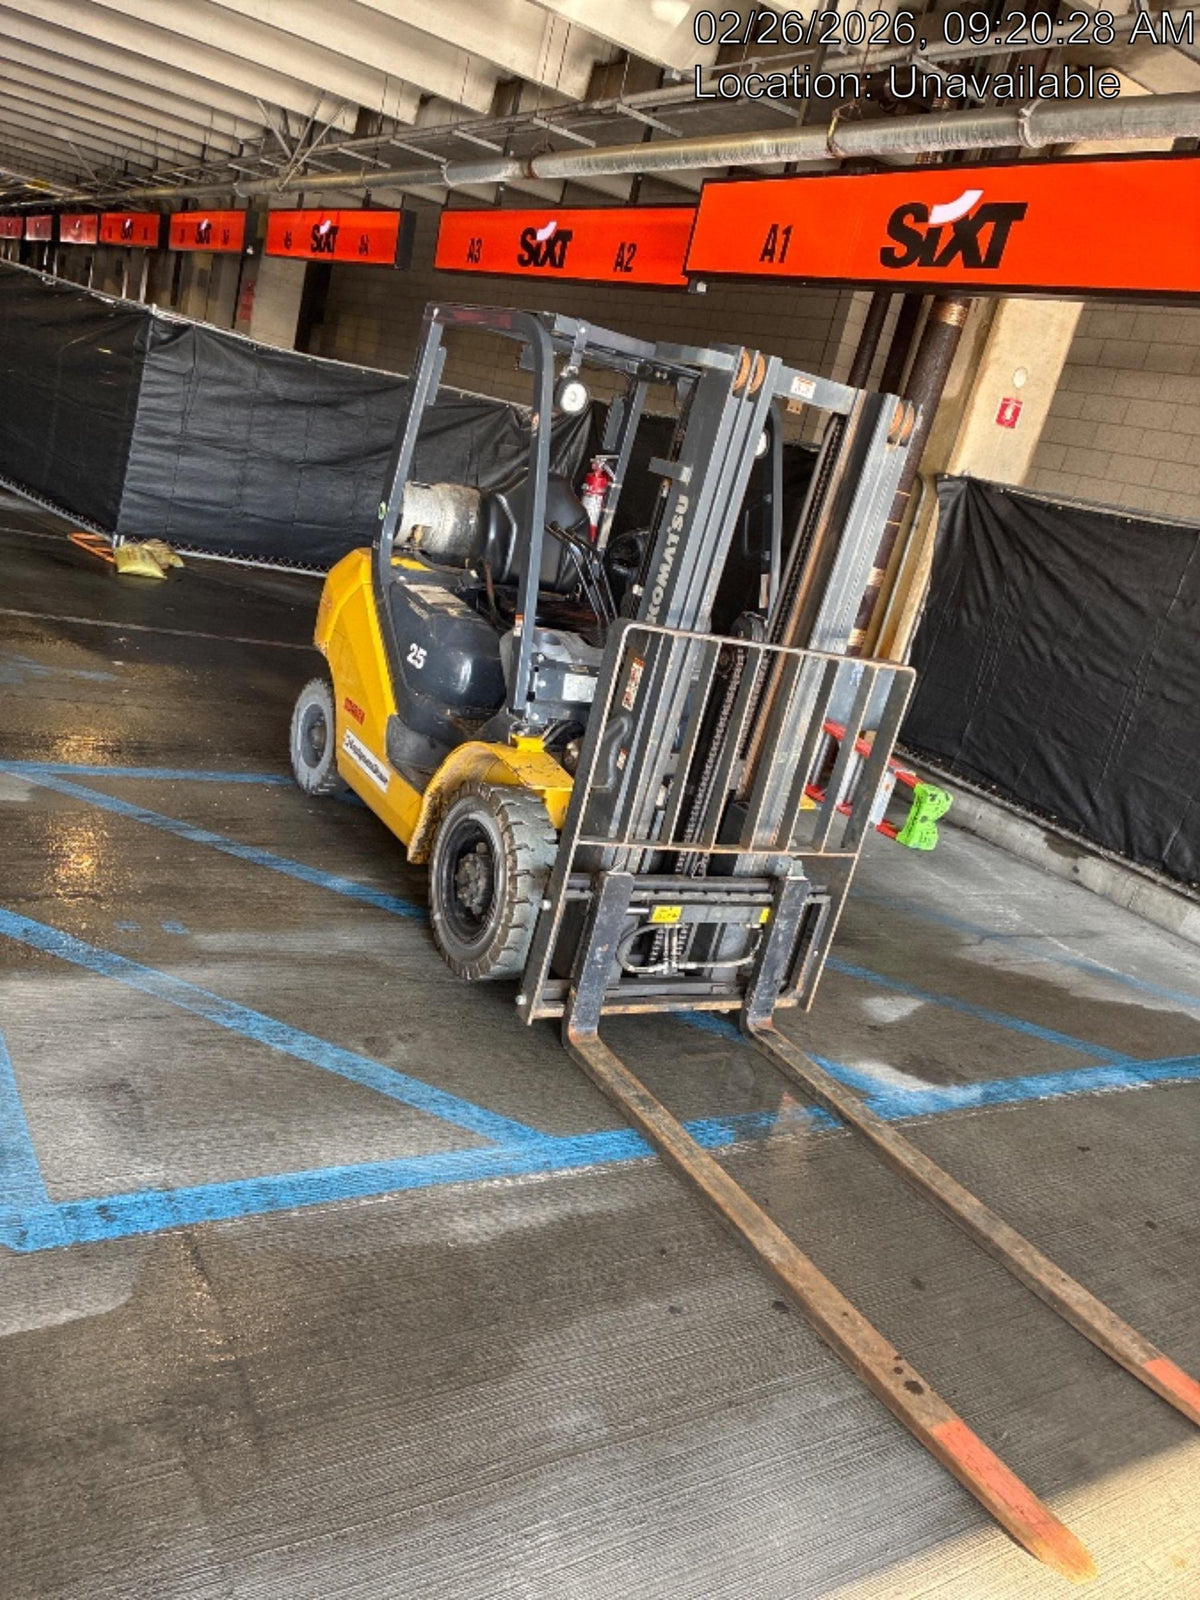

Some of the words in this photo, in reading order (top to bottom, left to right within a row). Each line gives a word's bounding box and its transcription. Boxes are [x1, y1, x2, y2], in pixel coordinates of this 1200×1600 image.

[466, 238, 483, 264] A3
[613, 242, 637, 273] A2
[759, 223, 793, 264] A1
[645, 494, 689, 625] KOMATSU
[406, 643, 428, 669] 25
